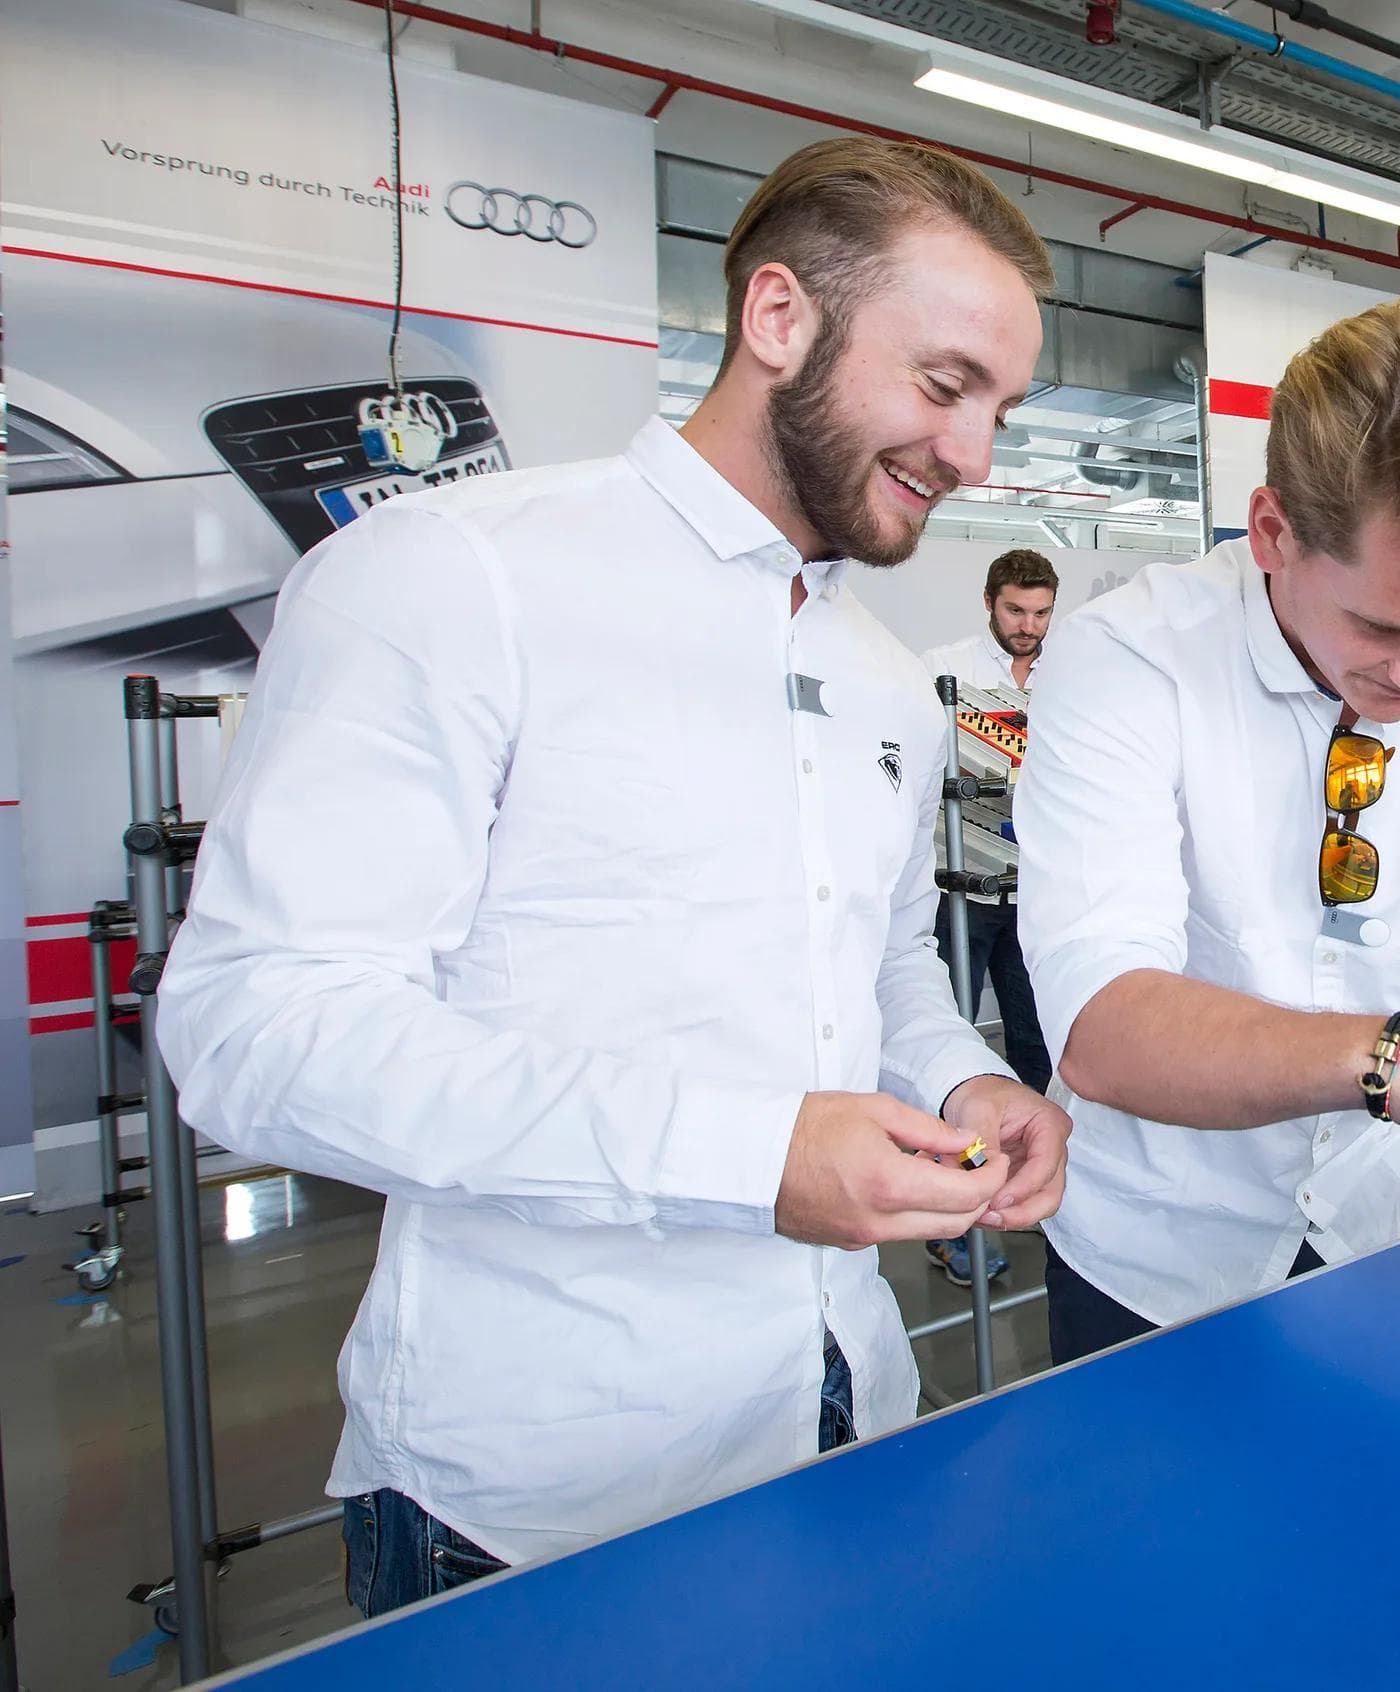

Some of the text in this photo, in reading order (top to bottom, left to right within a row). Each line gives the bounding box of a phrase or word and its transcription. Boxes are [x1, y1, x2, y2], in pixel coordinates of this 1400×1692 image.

[101, 138, 430, 217] Vorsprung durch Technik
[373, 176, 430, 198] Audi
[881, 741, 901, 752] ERC
